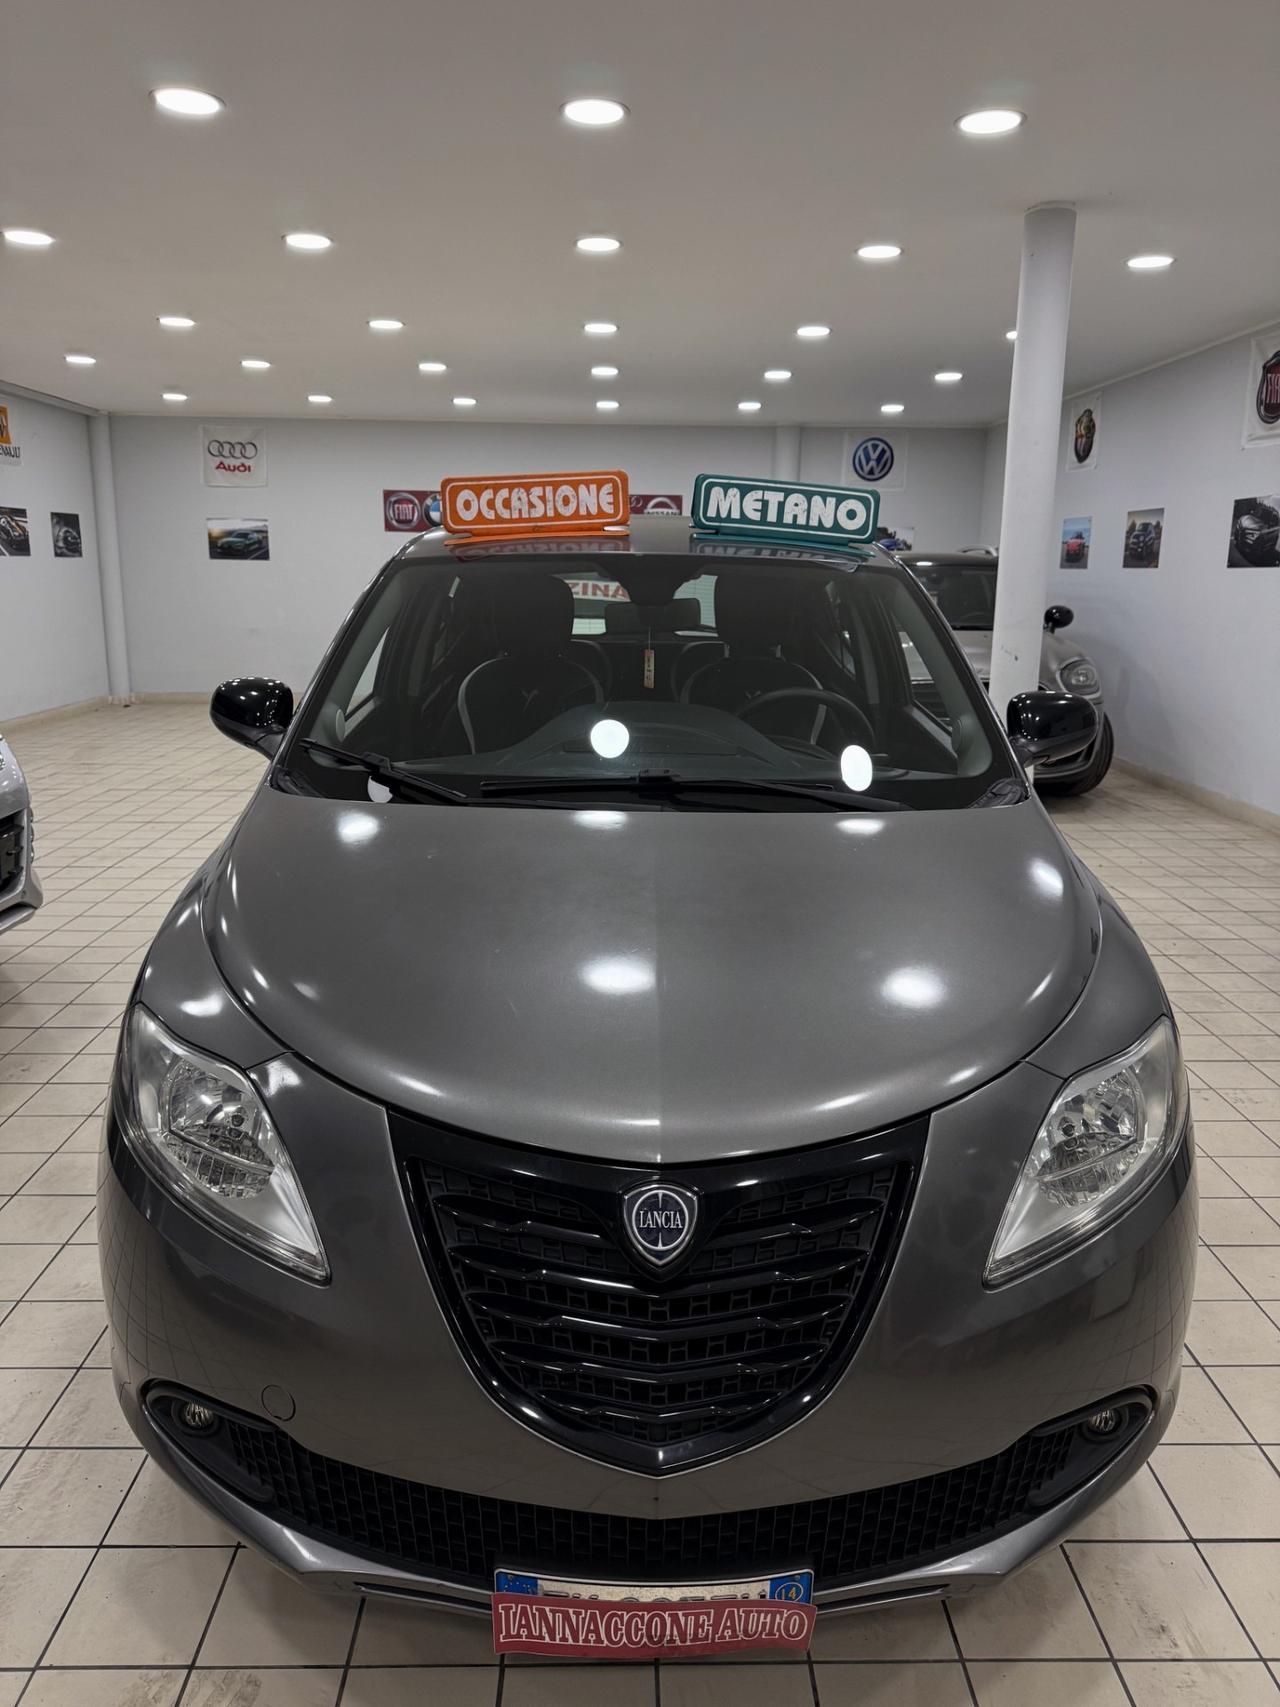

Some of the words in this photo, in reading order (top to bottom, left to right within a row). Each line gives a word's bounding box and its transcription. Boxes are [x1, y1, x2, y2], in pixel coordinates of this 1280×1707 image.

[215, 461, 251, 473] Audi
[394, 504, 413, 521] FIAT
[456, 482, 614, 521] OCCASIONE
[706, 486, 867, 531] METANO
[639, 1210, 683, 1229] LANCIA
[499, 1603, 713, 1647] IANNACCONE
[715, 1607, 808, 1642] AUTO
